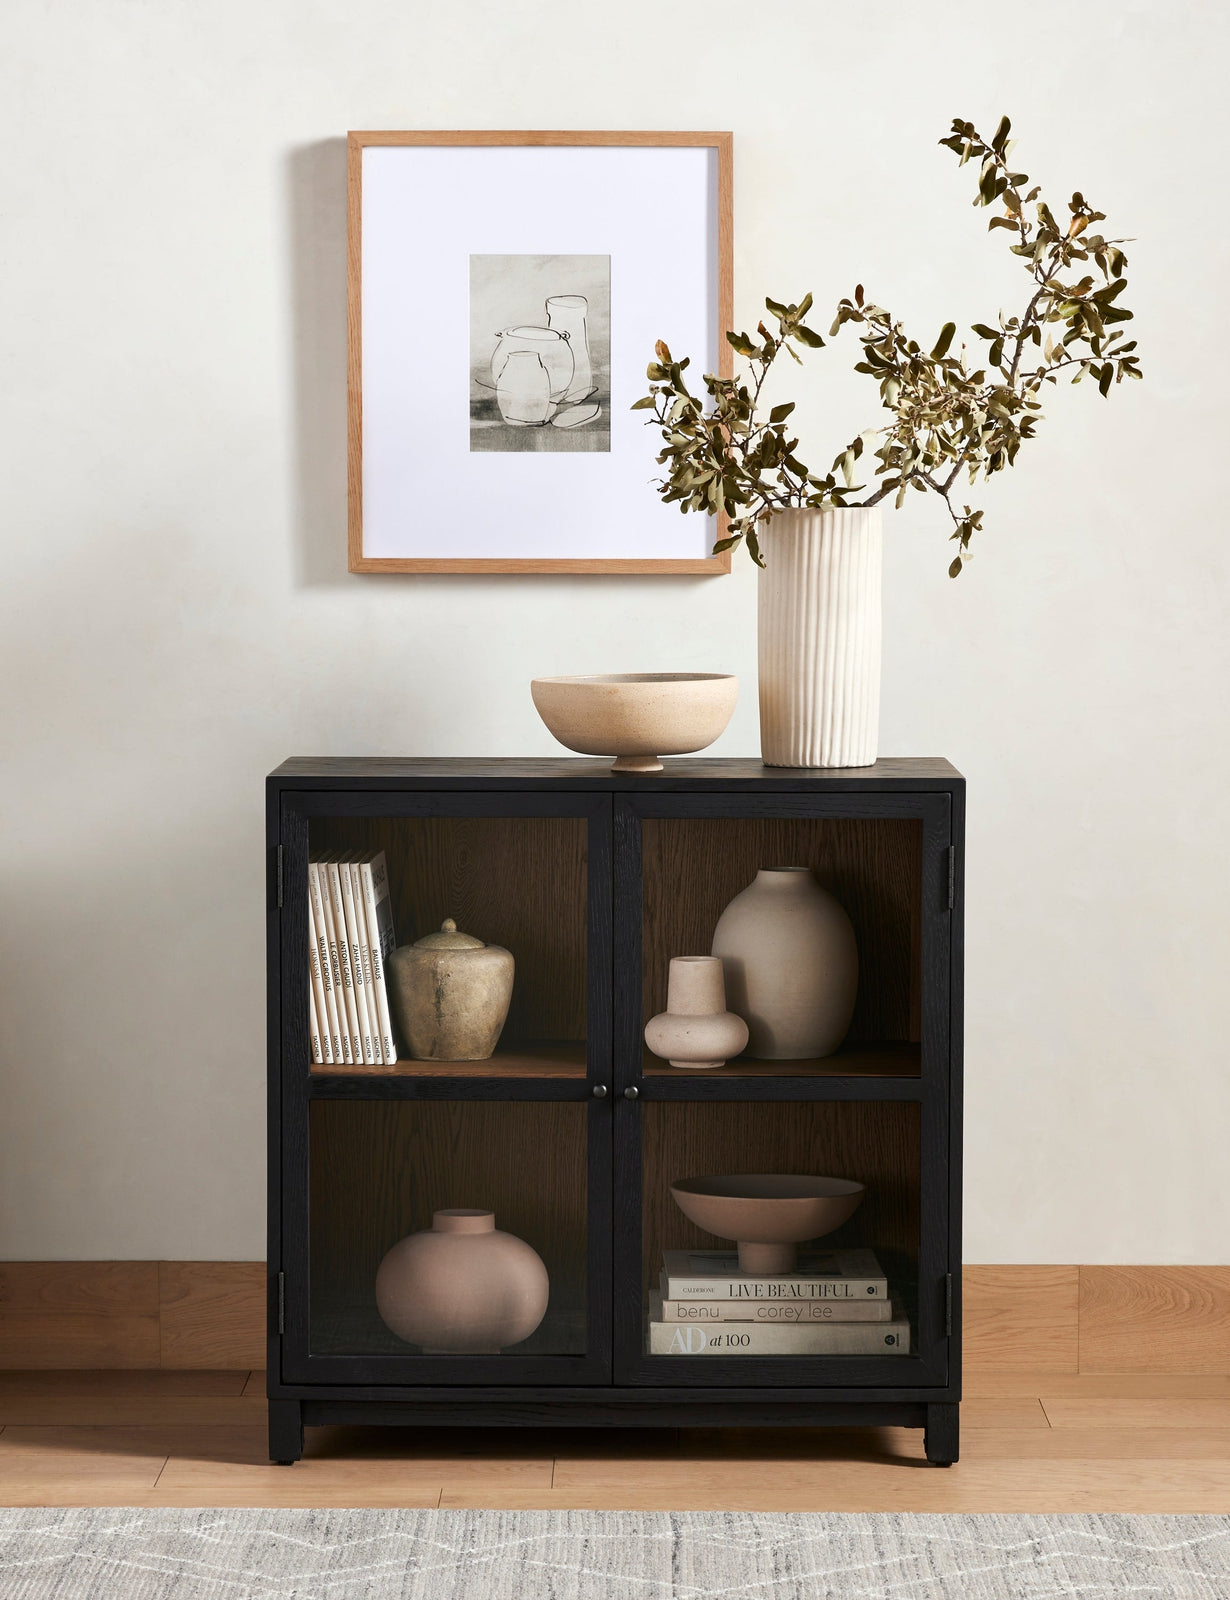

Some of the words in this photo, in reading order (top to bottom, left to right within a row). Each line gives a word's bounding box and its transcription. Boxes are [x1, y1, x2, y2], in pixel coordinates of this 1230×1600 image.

[319, 935, 328, 961] WALTER
[330, 941, 336, 949] LE
[340, 940, 348, 966] ANTONI
[352, 943, 360, 963] ZAHA
[331, 950, 341, 987] CORBUSIER
[372, 949, 381, 980] BAUHAUS
[323, 962, 332, 992] GROPIUS
[373, 1036, 381, 1058] TASCHEN
[383, 1036, 391, 1058] TASCHEN
[729, 1284, 764, 1297] LIVE
[768, 1284, 854, 1298] BEAUTIFUL
[677, 1303, 720, 1318] benu
[757, 1306, 803, 1322] corey
[808, 1302, 833, 1318] lee
[666, 1326, 707, 1355] AD
[709, 1334, 722, 1347] at
[725, 1333, 751, 1347] 100
